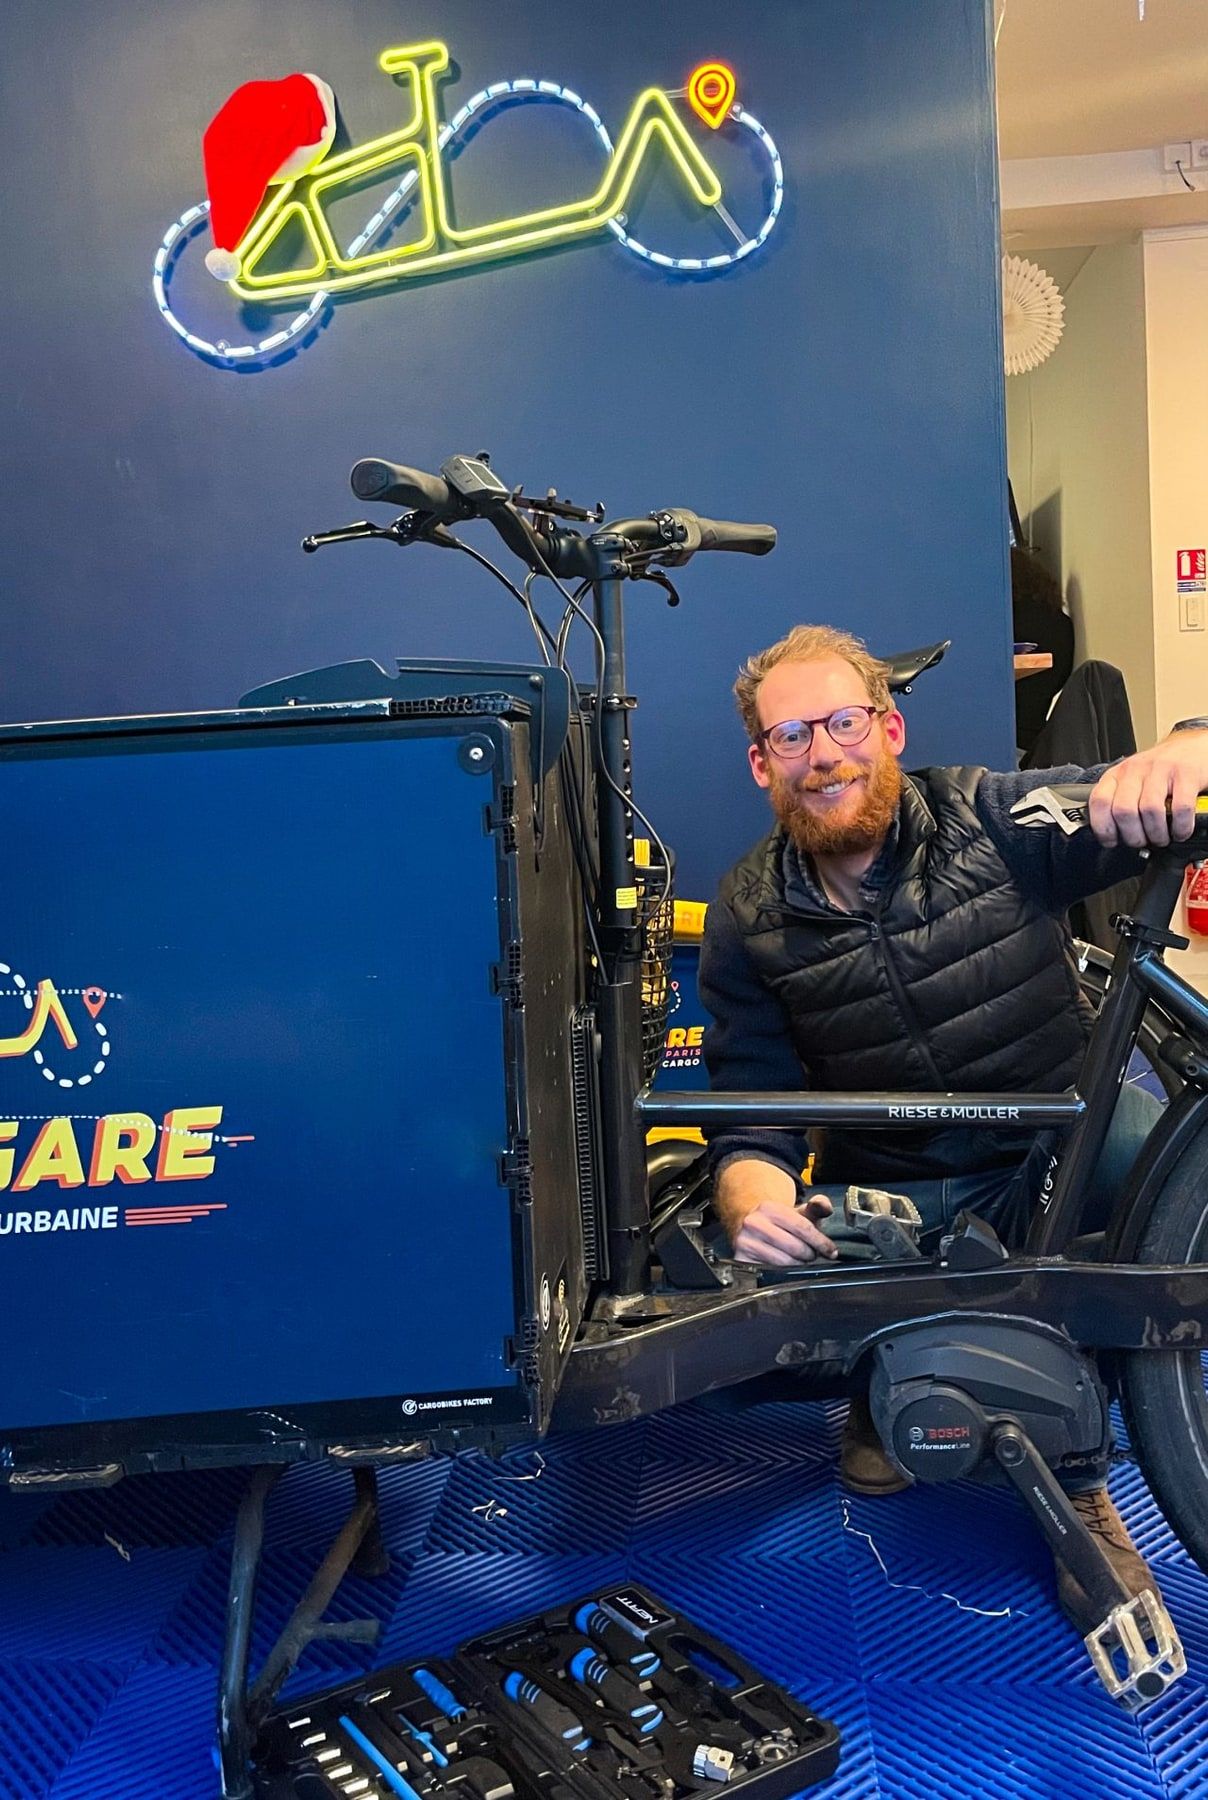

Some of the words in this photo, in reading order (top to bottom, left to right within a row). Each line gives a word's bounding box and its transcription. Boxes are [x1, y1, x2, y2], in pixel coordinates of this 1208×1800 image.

[665, 1048, 702, 1058] PARIS
[662, 1058, 700, 1068] CARGO
[463, 1397, 493, 1407] FACTORY
[928, 1426, 970, 1439] BOSCH
